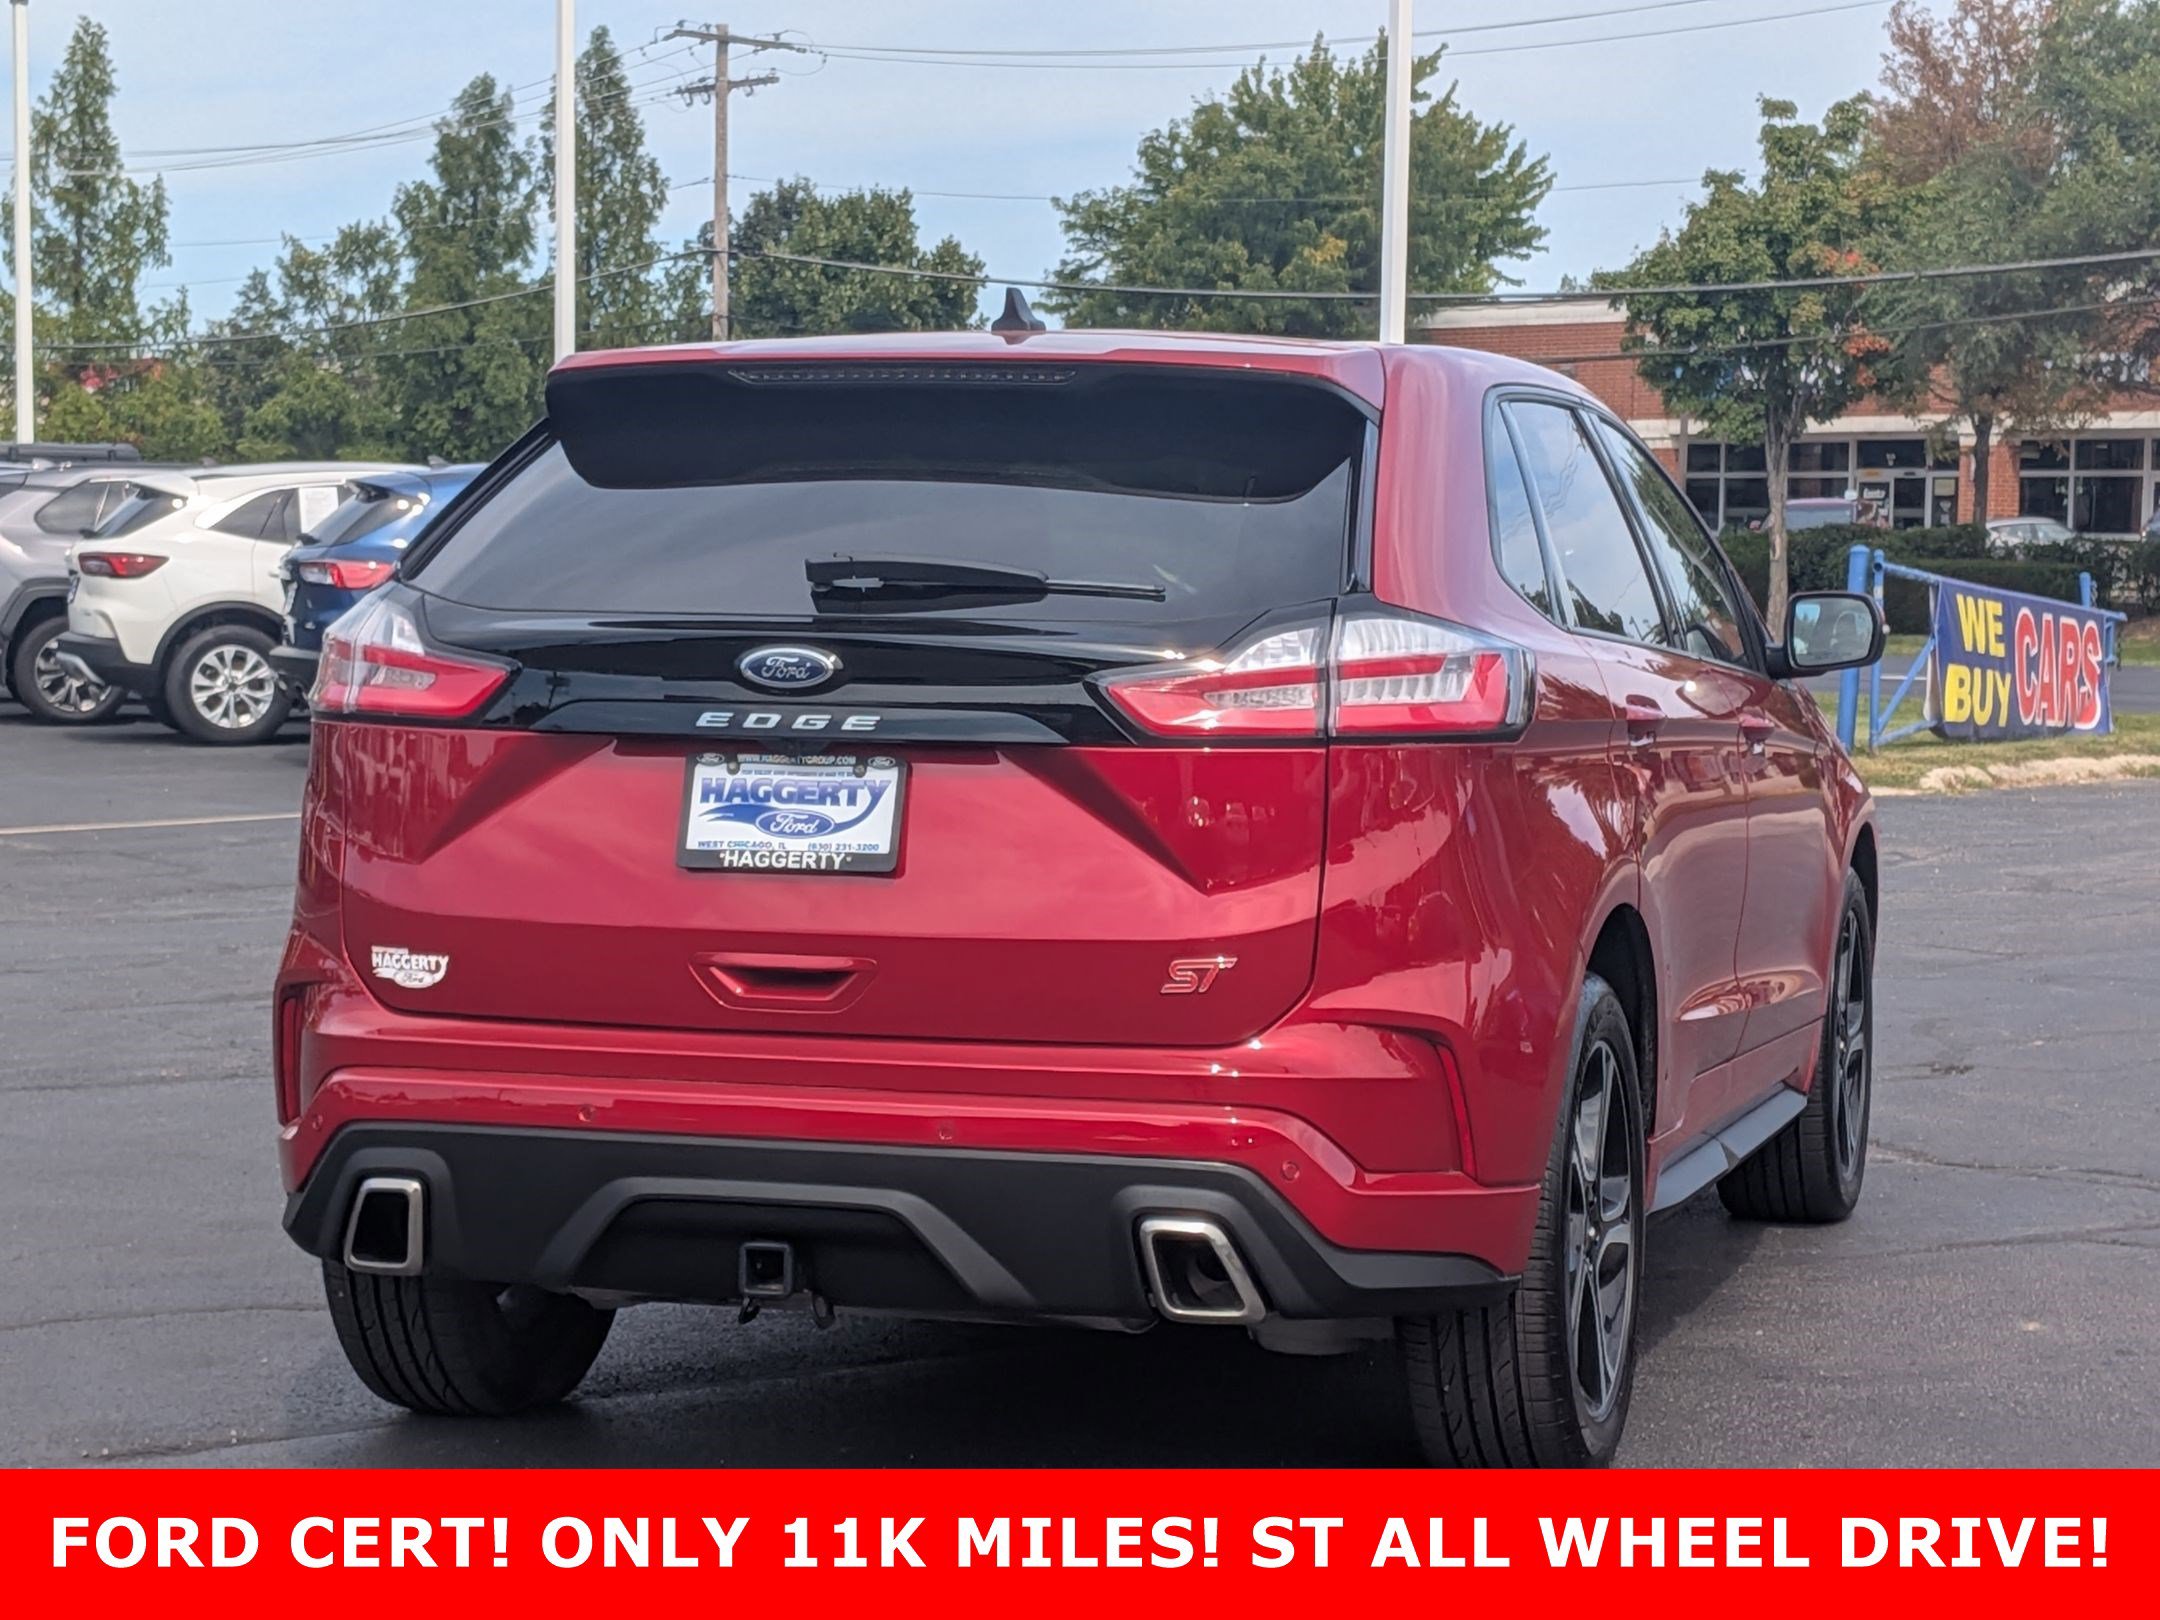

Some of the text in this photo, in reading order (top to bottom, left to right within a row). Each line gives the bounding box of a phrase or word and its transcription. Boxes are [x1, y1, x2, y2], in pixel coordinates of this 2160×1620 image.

[1956, 593, 2006, 658] WE
[761, 656, 811, 679] Ford
[2014, 606, 2103, 730] CARS
[1944, 663, 2012, 728] BUY
[696, 712, 881, 730] EDGE
[700, 777, 892, 807] HAGGERTY
[769, 813, 817, 834] Ford
[835, 843, 879, 851] 231-3200
[371, 951, 449, 971] HAGGERTY
[1160, 957, 1238, 993] ST
